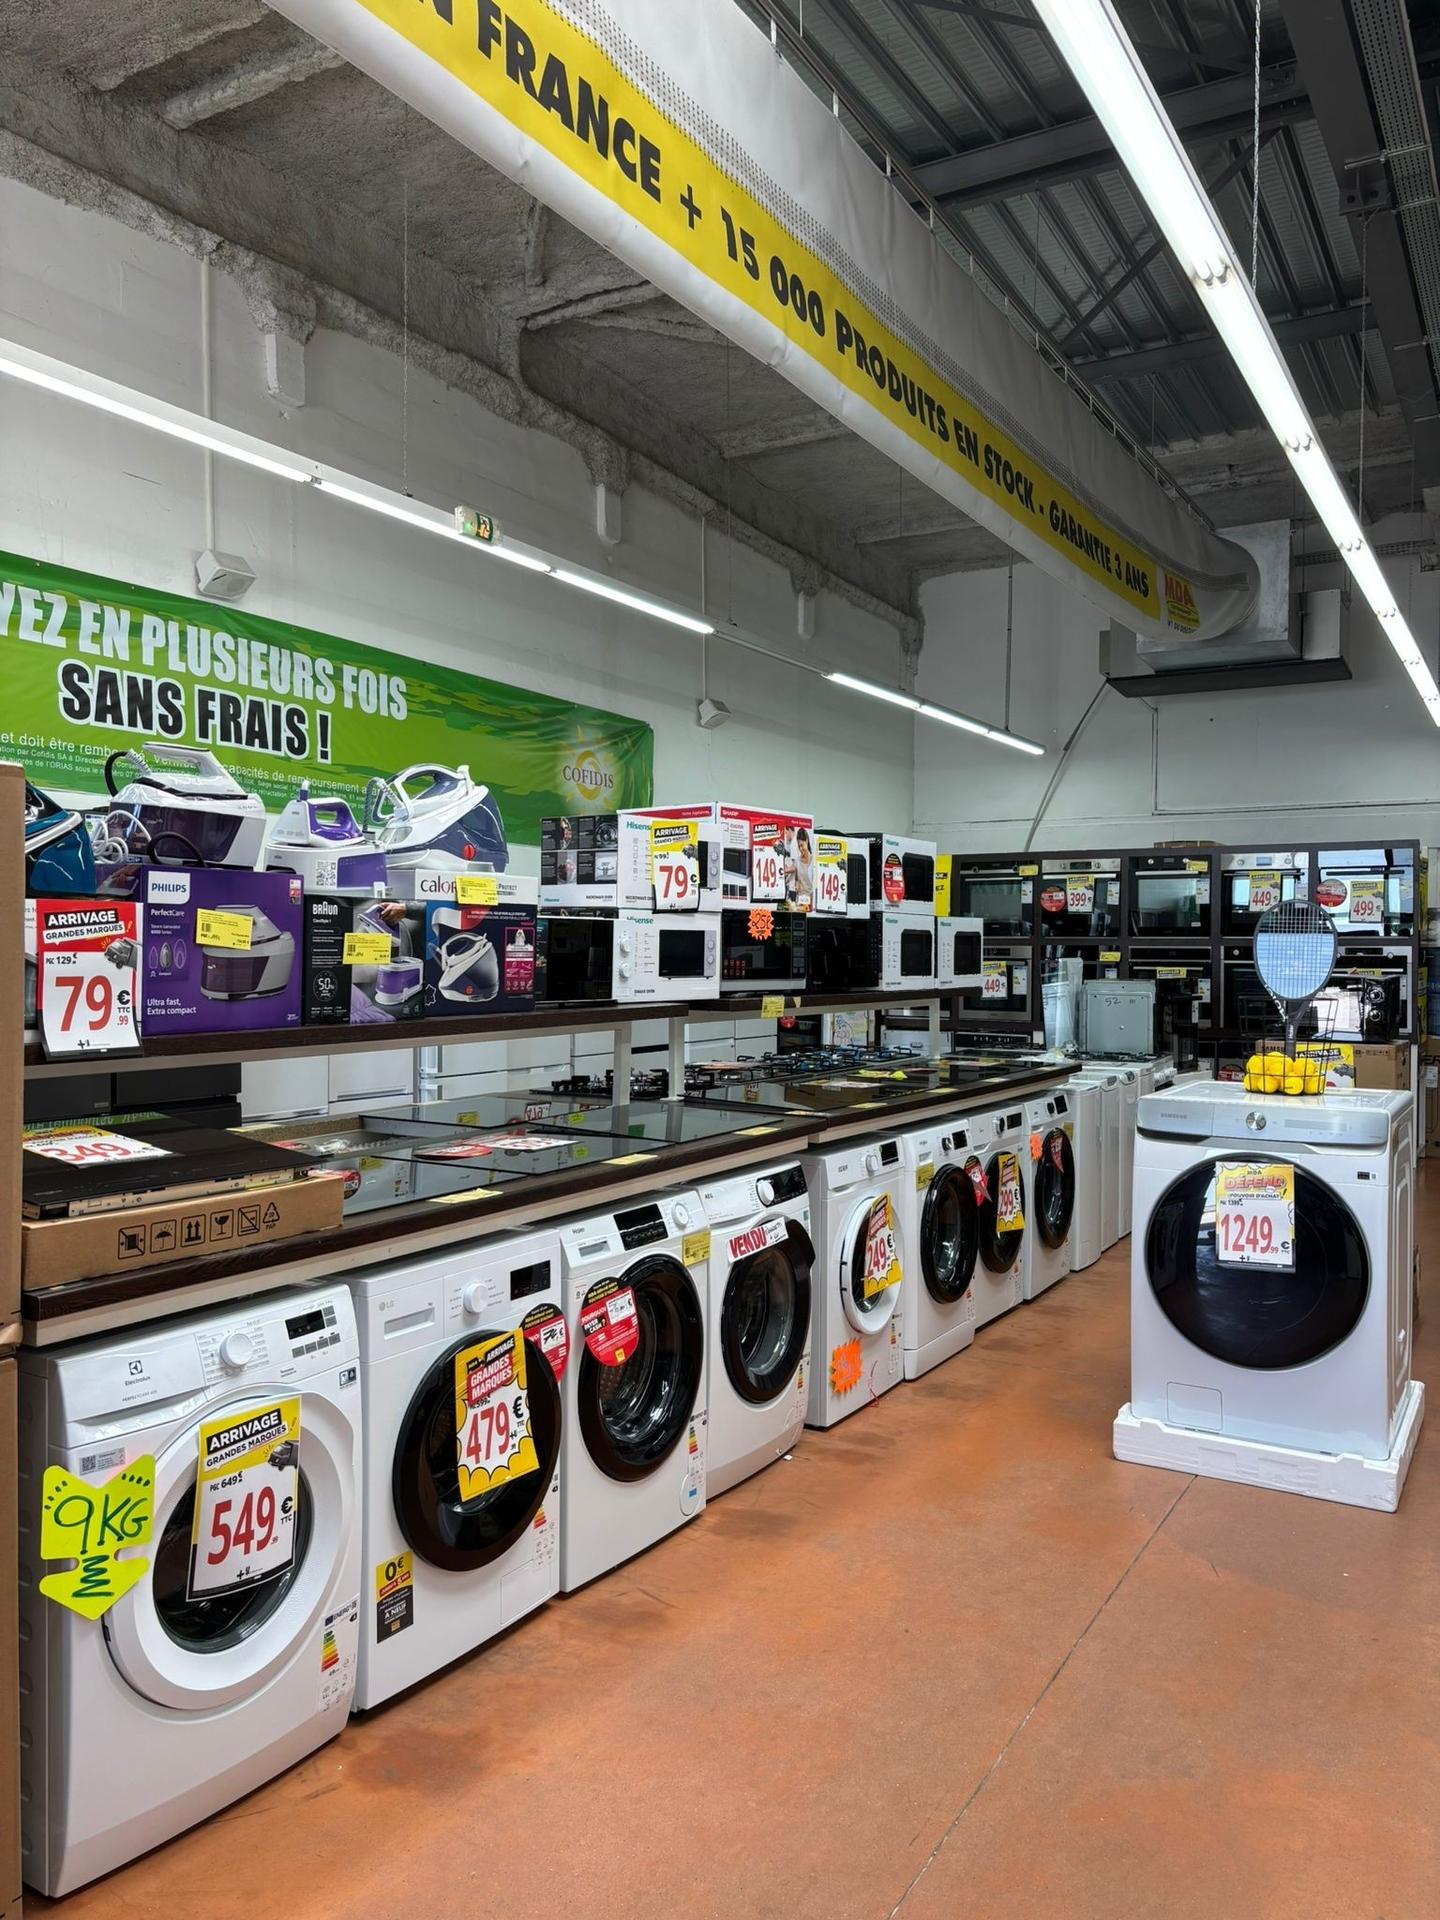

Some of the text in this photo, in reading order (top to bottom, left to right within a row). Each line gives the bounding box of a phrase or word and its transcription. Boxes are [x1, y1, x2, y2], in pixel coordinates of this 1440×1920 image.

[477, 0, 662, 203] FRANCE
[680, 184, 703, 230] +
[720, 206, 760, 281] 15
[770, 256, 827, 338] 000
[834, 308, 950, 444] PRODUITS
[953, 416, 979, 469] EN
[984, 442, 1036, 514] STOCK
[1048, 499, 1114, 575] GARANTIE
[1114, 552, 1123, 578] 3
[1125, 560, 1150, 598] ANS
[78, 601, 130, 662] EN
[143, 617, 337, 705] PLUSIEURS
[342, 666, 409, 721] FOIS
[59, 661, 332, 763] SANS FRAIS !
[1, 732, 75, 753] et doit être
[272, 770, 285, 782] de
[562, 765, 614, 790] COFIDIS
[656, 827, 688, 837] ARRIVAGE
[754, 824, 778, 833] ARRIVAGE
[659, 865, 688, 898] 79
[756, 858, 777, 888] 149
[151, 883, 187, 893] PHILIPS
[820, 873, 839, 902] 149
[312, 901, 339, 915] BRAUN
[1070, 893, 1086, 907] 399
[1252, 891, 1272, 906] 449
[1353, 901, 1374, 916] 499
[48, 910, 117, 927] ARRIVAGE
[151, 908, 185, 917] PerfectCare
[45, 929, 86, 941] GRANDES
[86, 924, 123, 936] MARQUES
[984, 978, 1001, 993] 449
[55, 975, 131, 1032] 79 €
[117, 1006, 131, 1014] TTC
[147, 998, 182, 1008] Ultra fast,
[147, 1006, 197, 1017] Extra compact
[40, 1142, 132, 1162] 349
[729, 1226, 767, 1258] VENDU
[1220, 1214, 1272, 1254] 1249
[867, 1237, 886, 1277] 249
[385, 1301, 395, 1309] LG
[590, 1324, 602, 1334] CASH
[486, 1338, 515, 1362] ARRIVAGE
[470, 1353, 510, 1387] GRANDES
[125, 1376, 151, 1386] Electrolux
[471, 1365, 513, 1401] MARQUES
[208, 1411, 280, 1451] ARRIVAGE
[465, 1396, 524, 1464] 479 €
[205, 1446, 248, 1468] GRANDES
[248, 1424, 287, 1449] MARQUES
[207, 1486, 294, 1565] 549 €
[280, 1515, 293, 1526] TTC
